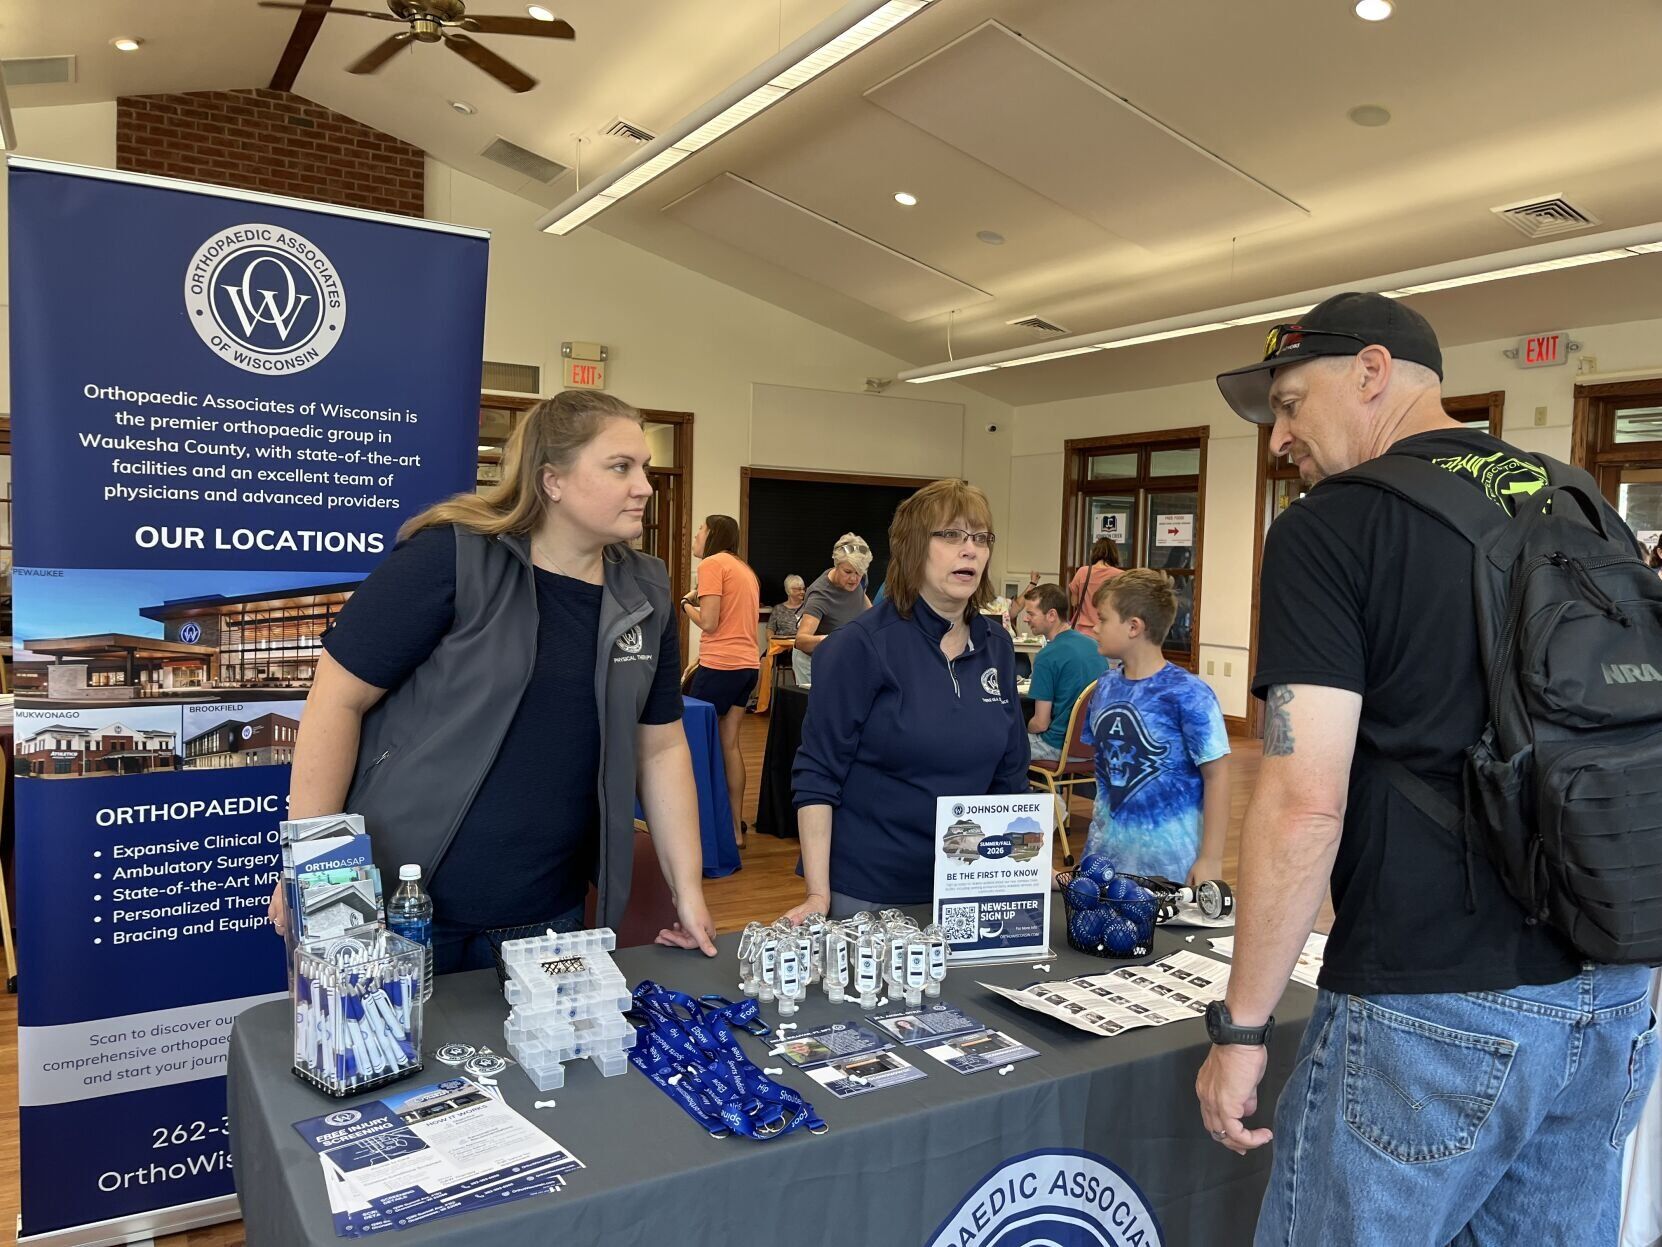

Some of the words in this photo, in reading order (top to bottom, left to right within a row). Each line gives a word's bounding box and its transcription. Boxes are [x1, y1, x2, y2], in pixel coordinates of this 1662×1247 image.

[190, 229, 272, 296] ORTHOPAEDIC
[276, 233, 342, 309] ASSOCIATES
[210, 334, 231, 353] OF
[233, 347, 320, 371] WISCONSIN
[1526, 335, 1559, 364] EXIT
[572, 365, 598, 385] EXIT
[84, 384, 197, 406] Orthopaedic
[203, 393, 294, 414] Associates
[300, 402, 316, 416] of
[320, 403, 401, 422] Wisconsin
[405, 409, 418, 423] is
[115, 410, 145, 426] the
[150, 415, 218, 432] premier
[223, 420, 323, 440] orthopaedic
[327, 428, 373, 446] group
[379, 430, 391, 443] in
[79, 433, 179, 453] Waukesha
[184, 439, 250, 459] County,
[255, 445, 292, 459] with
[297, 448, 421, 466] state-of-the-art
[112, 459, 187, 477] facilities
[192, 464, 226, 479] and
[231, 468, 252, 480] an
[257, 468, 329, 484] excellent
[333, 473, 373, 486] team
[378, 473, 393, 487] of
[104, 484, 199, 503] physicians
[205, 488, 237, 502] and
[242, 489, 323, 505] advanced
[327, 493, 400, 509] providers
[135, 526, 204, 550] OUR
[216, 528, 385, 553] LOCATIONS
[12, 568, 64, 578] PEWAUKEE
[1601, 663, 1662, 684] NRA
[16, 711, 80, 720] MUKWONAGO
[189, 704, 243, 714] BROOKFIELD
[1109, 717, 1124, 736] A
[96, 795, 279, 826] ORTHOPAEDIC
[966, 805, 1009, 814] JOHNSON
[1012, 804, 1040, 812] CREEK
[113, 839, 200, 860] Expansive
[204, 832, 262, 850] Clinical
[266, 831, 279, 843] O
[987, 846, 1004, 854] 2026
[113, 861, 213, 882] Ambulatory
[217, 853, 279, 874] Surgery
[305, 857, 365, 872] ORTHOASAP
[960, 872, 974, 880] THE
[977, 870, 998, 879] FIRST
[1001, 870, 1012, 878] TO
[1014, 869, 1038, 878] KNOW
[113, 876, 250, 903] State-of-the-Art
[254, 871, 280, 886] MR
[113, 898, 220, 924] Personalized
[225, 893, 272, 910] Thera
[980, 912, 1002, 921] SIGN
[1004, 912, 1016, 920] UP
[981, 901, 1038, 912] NEWSLETTER
[113, 925, 179, 946] Bracing
[182, 917, 214, 935] and
[90, 1032, 127, 1046] Scan
[131, 1029, 146, 1040] to
[150, 1019, 212, 1037] discover
[691, 1026, 708, 1044] Elbow
[718, 1030, 729, 1043] Hip
[42, 1046, 156, 1072] comprehensive
[650, 1046, 662, 1062] Knee
[668, 1048, 684, 1060] Sports
[731, 1046, 744, 1062] Knee
[83, 1071, 112, 1086] and
[117, 1065, 152, 1080] start
[156, 1060, 188, 1076] your
[190, 1053, 228, 1070] journ
[712, 1078, 728, 1094] Elbow
[757, 1084, 769, 1094] Hip
[780, 1090, 803, 1105] Shoulde
[426, 1118, 447, 1126] HOW
[456, 1104, 488, 1118] WORKS
[316, 1129, 348, 1143] FREE
[348, 1116, 388, 1132] INJURY
[322, 1122, 394, 1147] SCREENING
[947, 1172, 1038, 1247] AEDIC
[1048, 1170, 1150, 1247] ASSOCIA
